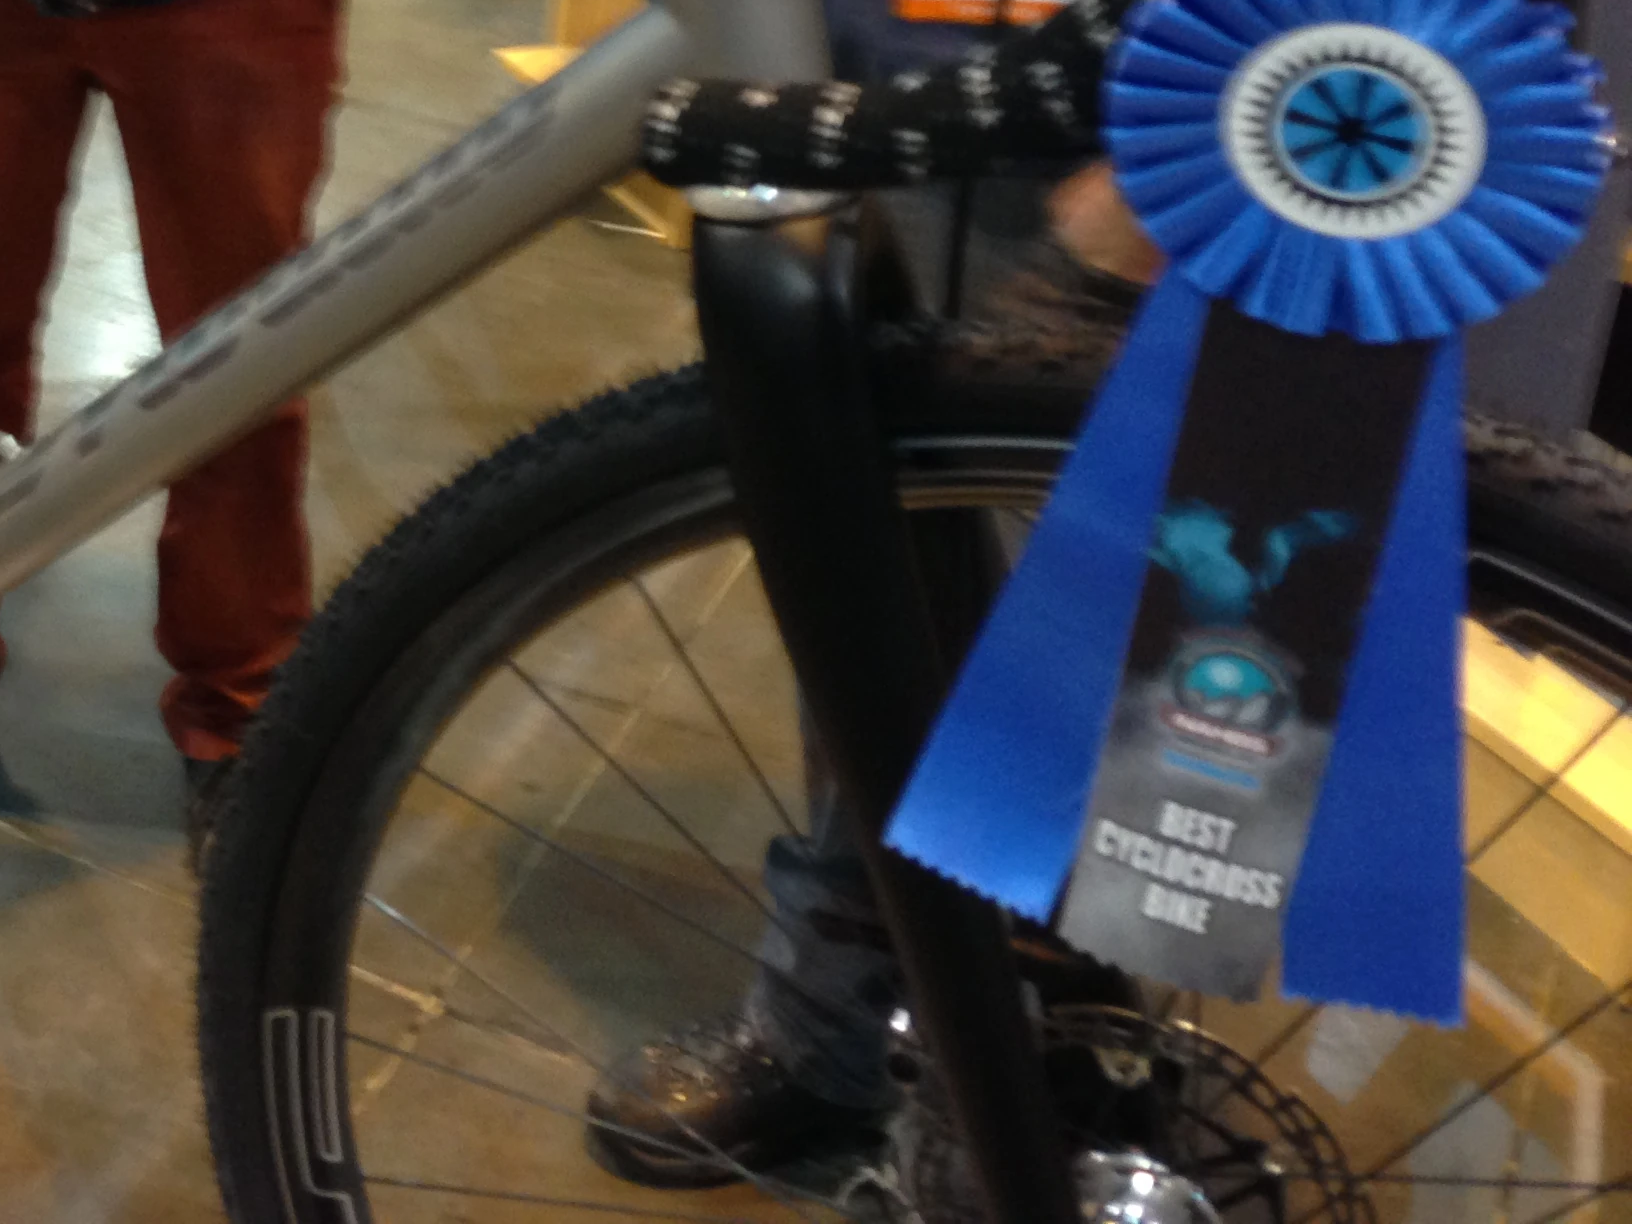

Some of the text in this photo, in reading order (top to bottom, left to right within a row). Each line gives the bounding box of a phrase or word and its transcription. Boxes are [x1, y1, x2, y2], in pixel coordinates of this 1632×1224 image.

[1160, 799, 1238, 853] BEST
[1094, 818, 1284, 910] CYCLOCROSS
[1140, 884, 1214, 934] BIKE
